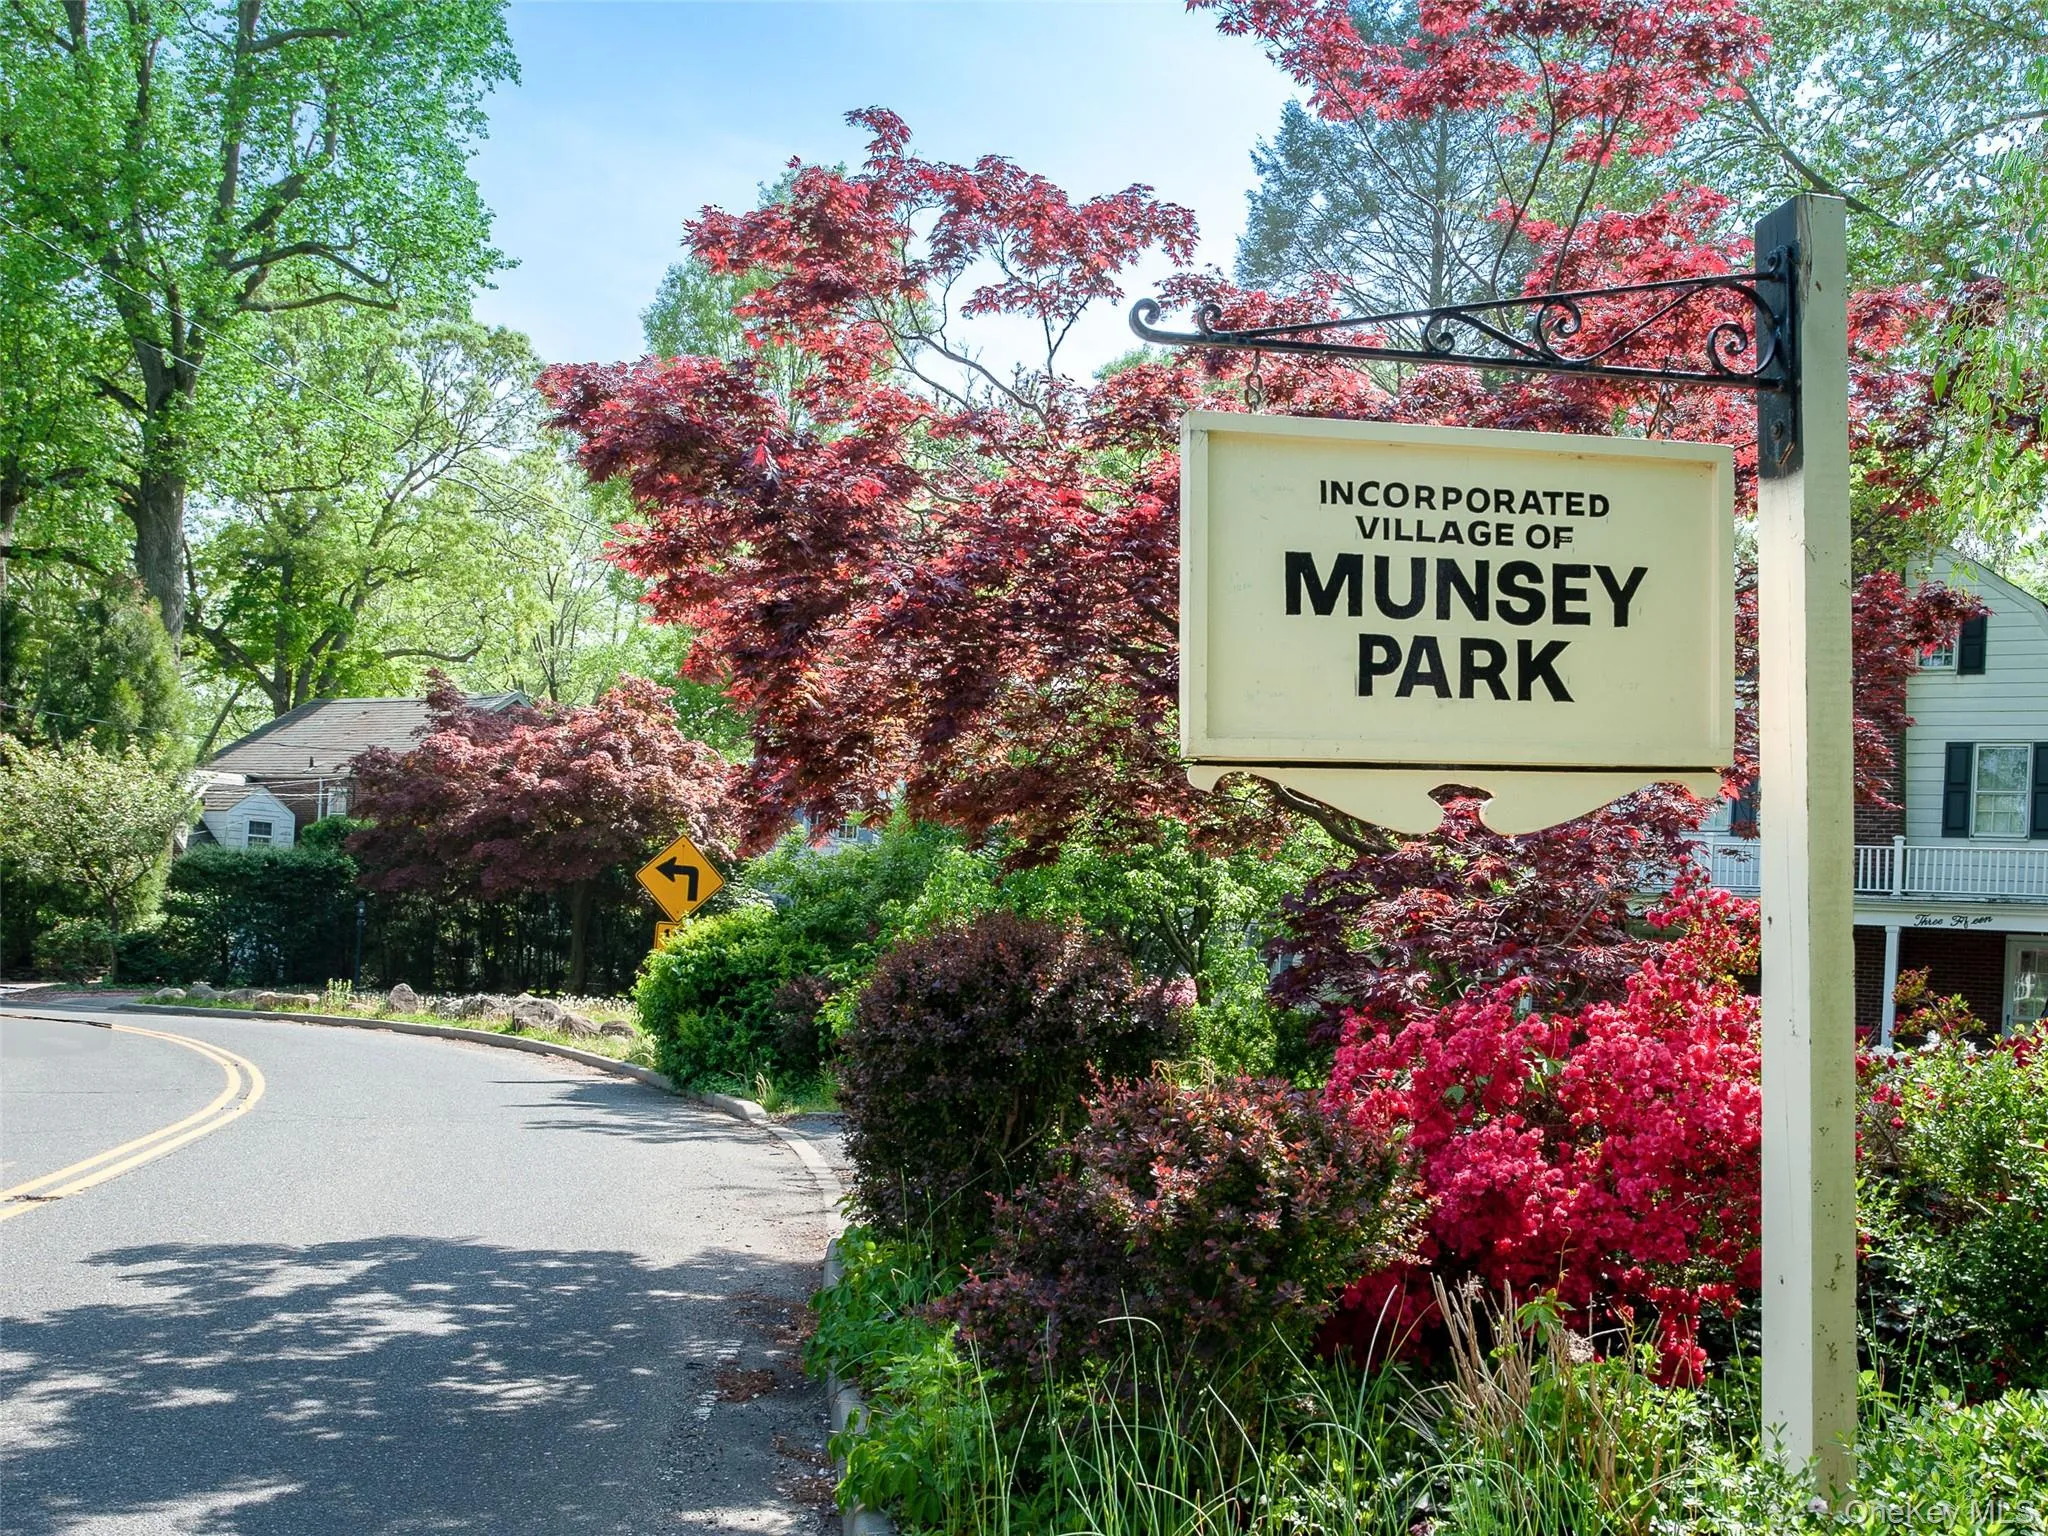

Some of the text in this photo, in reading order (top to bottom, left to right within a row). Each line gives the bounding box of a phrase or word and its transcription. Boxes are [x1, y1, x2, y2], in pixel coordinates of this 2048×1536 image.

[1319, 479, 1610, 518] INCORPORATED
[1355, 515, 1575, 550] VILLAGE OF
[1284, 551, 1649, 628] MUNSEY
[1358, 633, 1575, 703] PARK
[1913, 913, 1944, 927] Three
